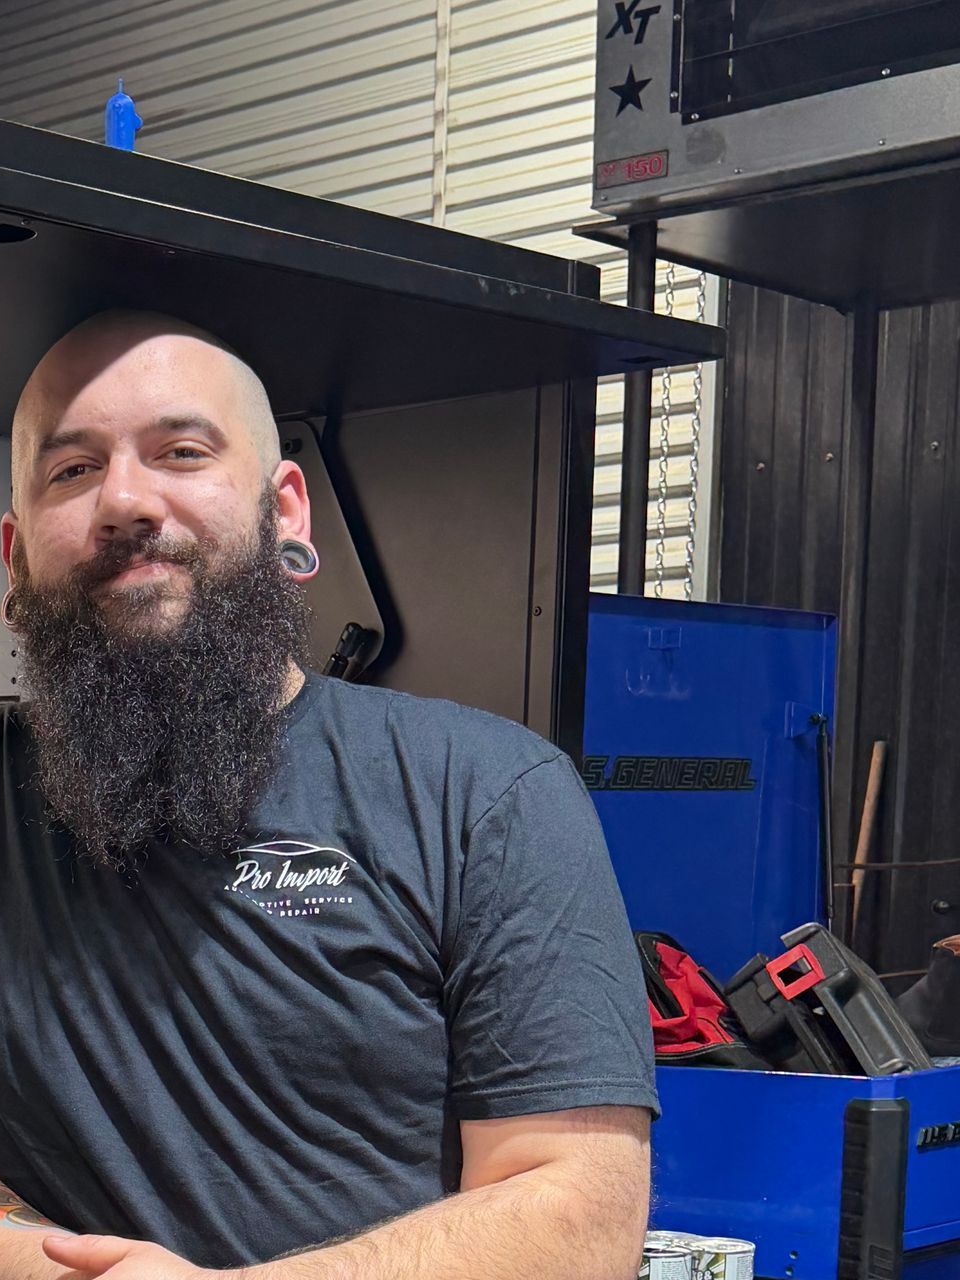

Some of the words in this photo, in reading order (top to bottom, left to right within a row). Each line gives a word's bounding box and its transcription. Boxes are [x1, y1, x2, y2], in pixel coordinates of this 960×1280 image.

[604, 0, 662, 46] XT
[623, 154, 664, 180] 150
[232, 860, 272, 890] Pro
[275, 859, 350, 892] Import
[304, 896, 353, 905] SERVICE
